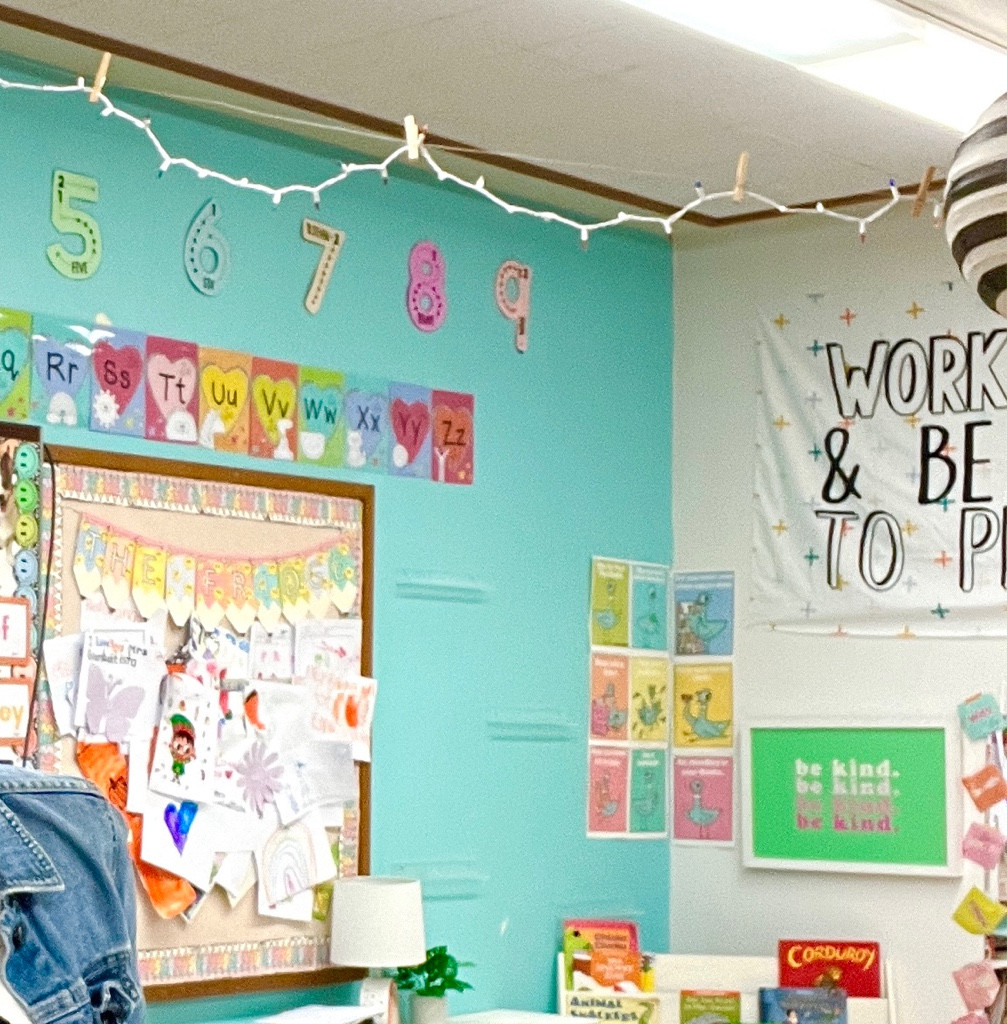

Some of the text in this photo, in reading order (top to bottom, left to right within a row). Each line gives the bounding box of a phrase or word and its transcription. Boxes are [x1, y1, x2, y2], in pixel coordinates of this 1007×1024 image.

[47, 168, 102, 280] 5
[184, 197, 232, 297] 6
[302, 217, 346, 316] 7
[407, 240, 449, 334] 8
[495, 260, 532, 354] 9
[46, 352, 79, 384] Rr
[102, 359, 131, 390] Ss
[826, 327, 1007, 419] WORK
[159, 372, 187, 406] Tt
[211, 382, 239, 409] Uu
[262, 389, 290, 419] Vv
[304, 398, 338, 425] Ww
[357, 405, 381, 434] Xx
[399, 415, 421, 444] Yy
[442, 420, 467, 447] Zz
[821, 420, 992, 506] & BE
[815, 506, 1007, 594] TO P
[795, 758, 901, 778] be kind.
[787, 944, 876, 971] CORDUROY
